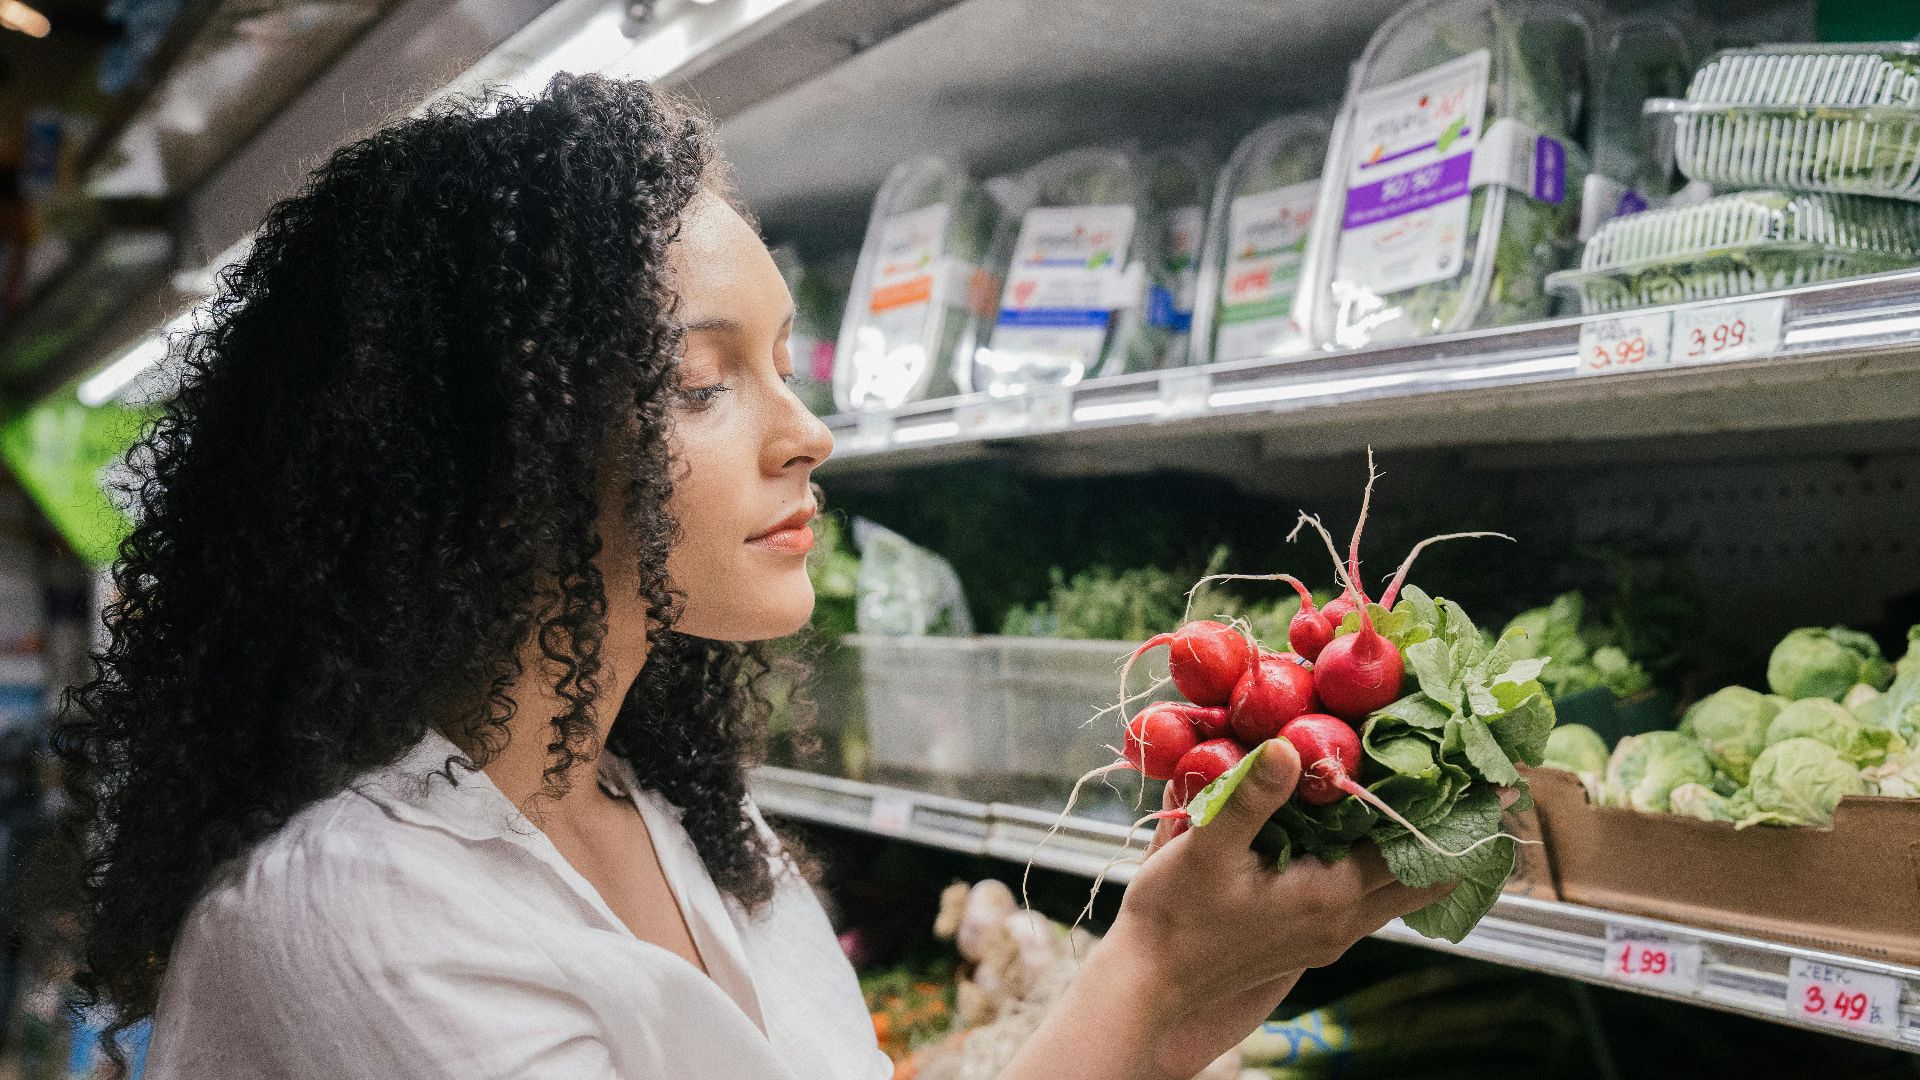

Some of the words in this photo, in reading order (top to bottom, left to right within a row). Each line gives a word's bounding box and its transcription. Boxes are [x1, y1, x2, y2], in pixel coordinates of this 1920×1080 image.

[1590, 336, 1646, 370] 3.99
[1688, 319, 1746, 357] 3.99
[1619, 943, 1667, 974] 1.99
[1804, 985, 1868, 1021] 3.49
